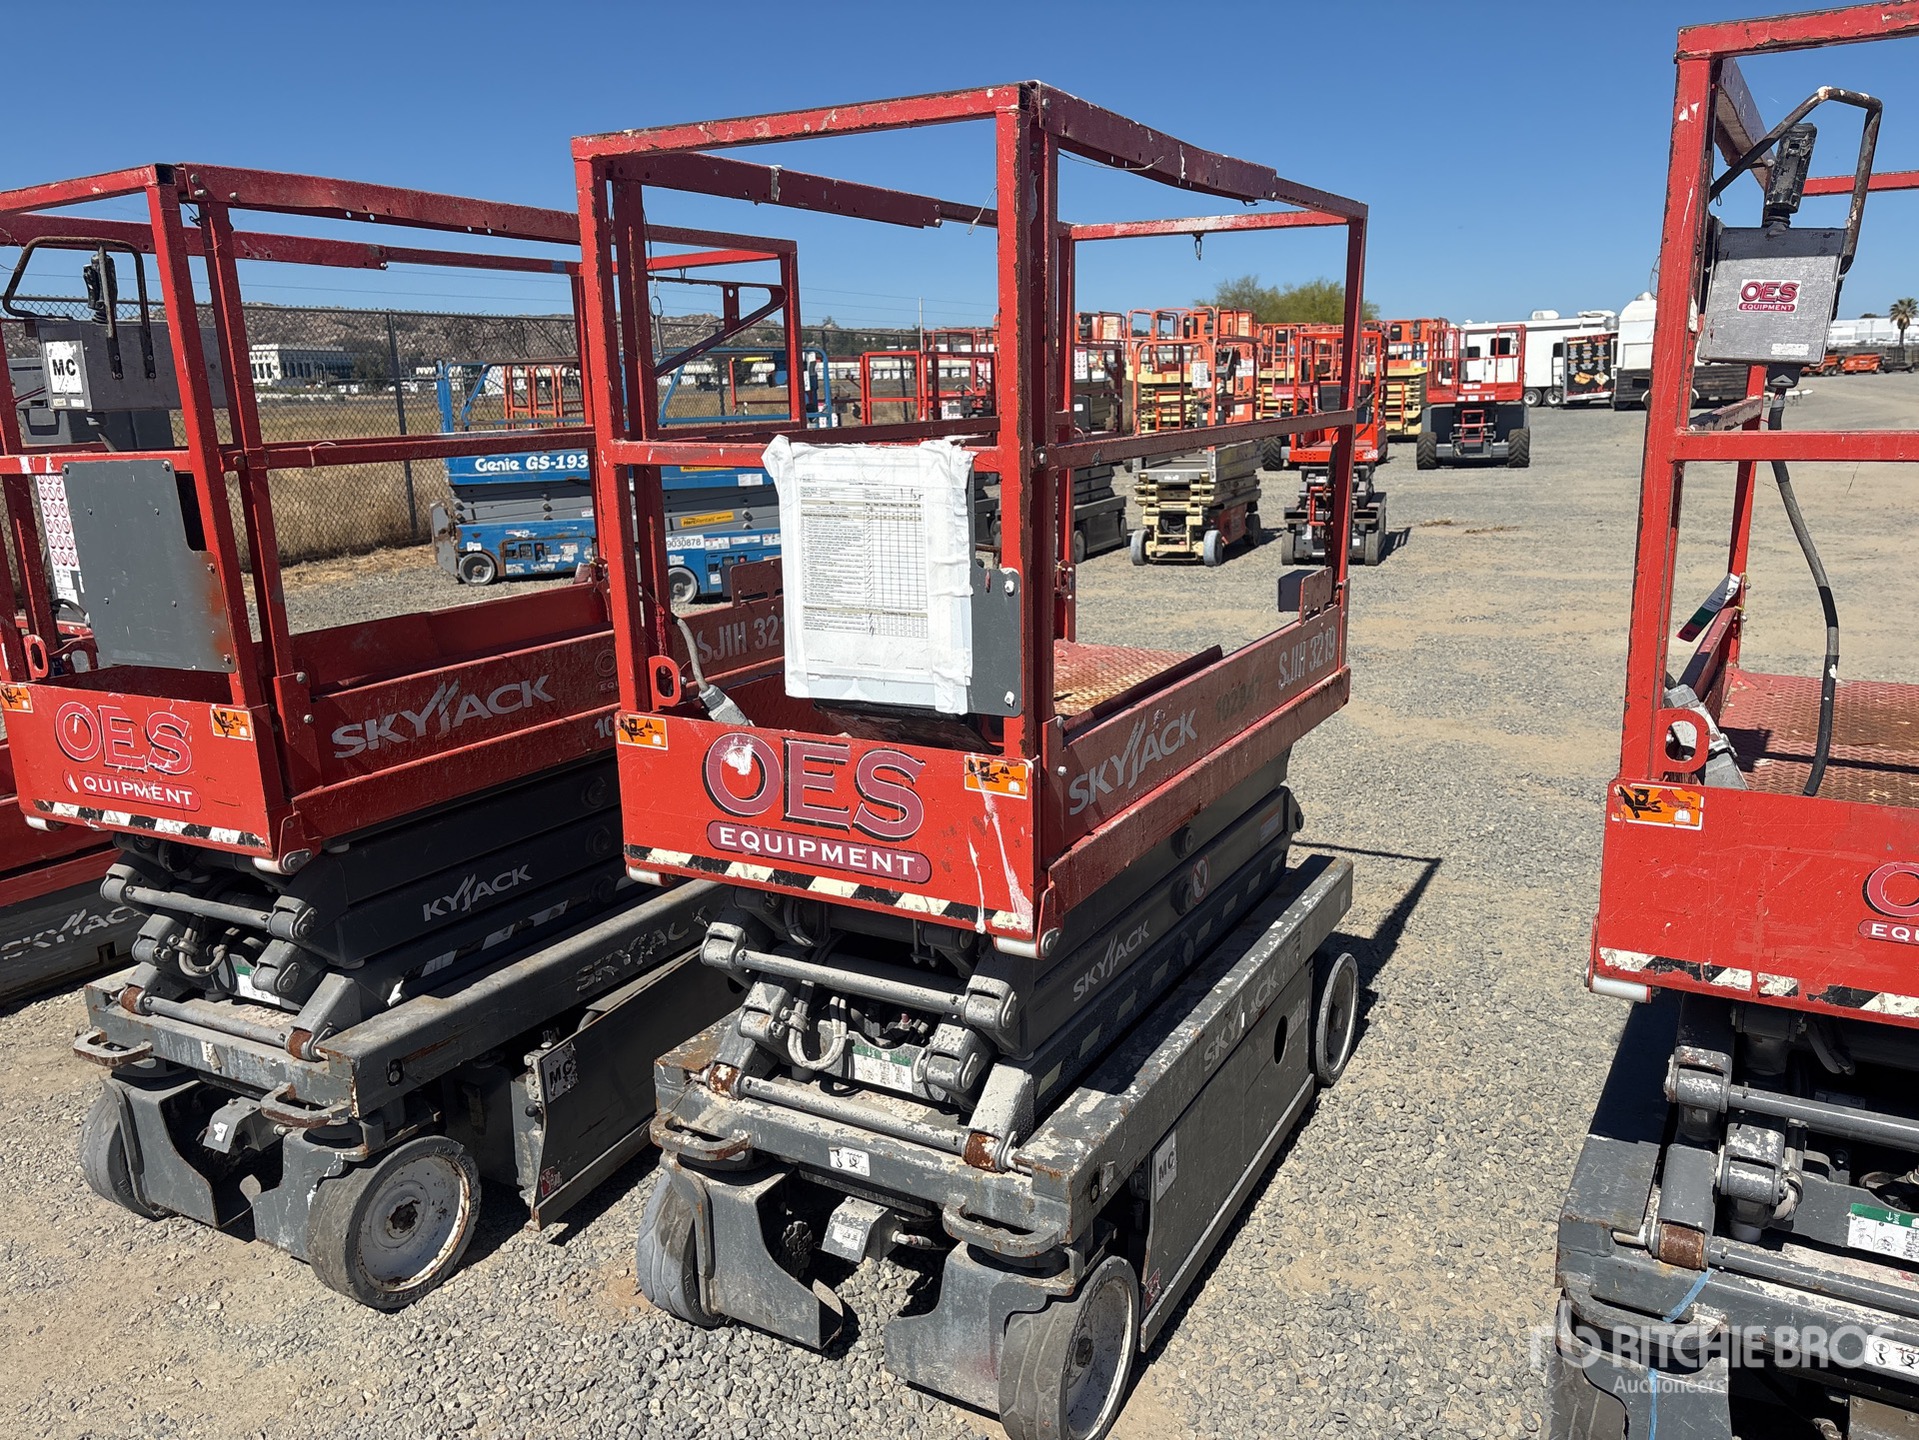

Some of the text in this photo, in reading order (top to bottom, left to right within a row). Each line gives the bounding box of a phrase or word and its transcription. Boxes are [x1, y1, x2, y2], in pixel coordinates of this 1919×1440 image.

[1741, 281, 1800, 303] OES
[1742, 303, 1793, 312] EQUIPMENT
[52, 358, 76, 377] MC
[475, 454, 588, 472] Genie GS-193
[1309, 625, 1336, 673] 3219
[55, 701, 193, 776] OES
[331, 675, 555, 759] SKYJACK
[1069, 707, 1198, 816] SKYJACK
[702, 731, 927, 842] OES
[720, 826, 914, 876] EQUIPMENT
[1073, 920, 1150, 1002] SKYJACK
[1158, 1150, 1175, 1183] MC
